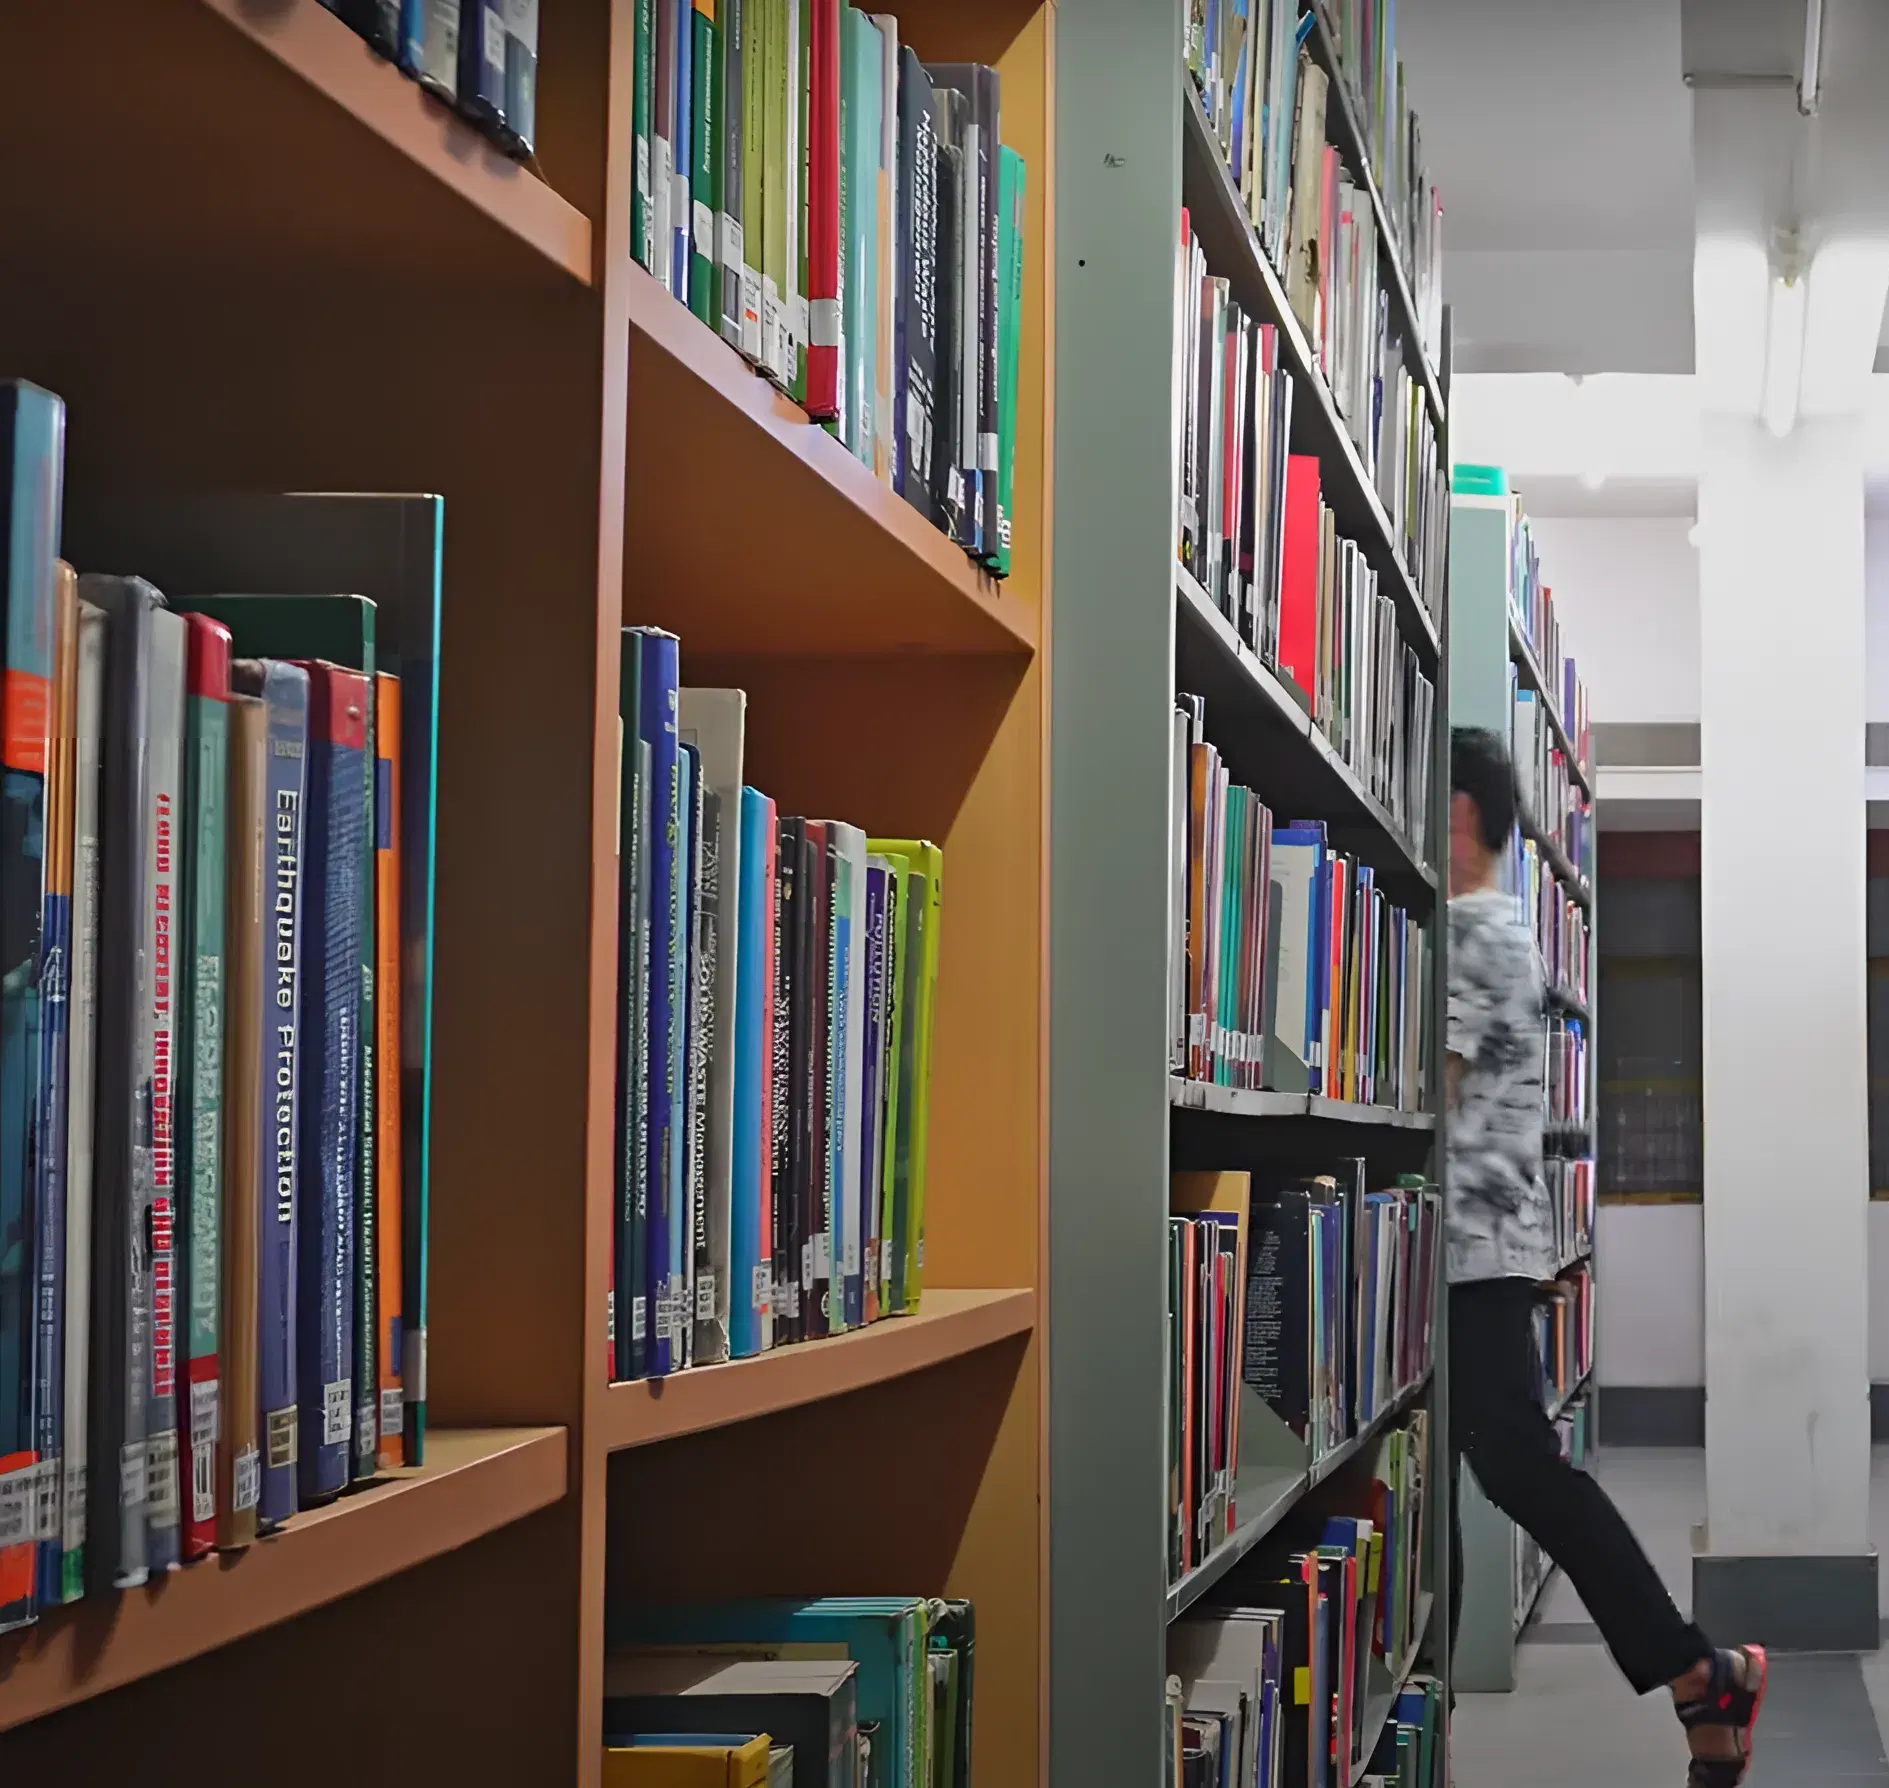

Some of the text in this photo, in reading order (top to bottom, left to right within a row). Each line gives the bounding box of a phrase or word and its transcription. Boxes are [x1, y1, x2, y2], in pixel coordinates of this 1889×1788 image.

[275, 788, 300, 1225] Earthquake Protection
[696, 1027, 708, 1107] WASTE
[694, 1111, 706, 1249] Management
